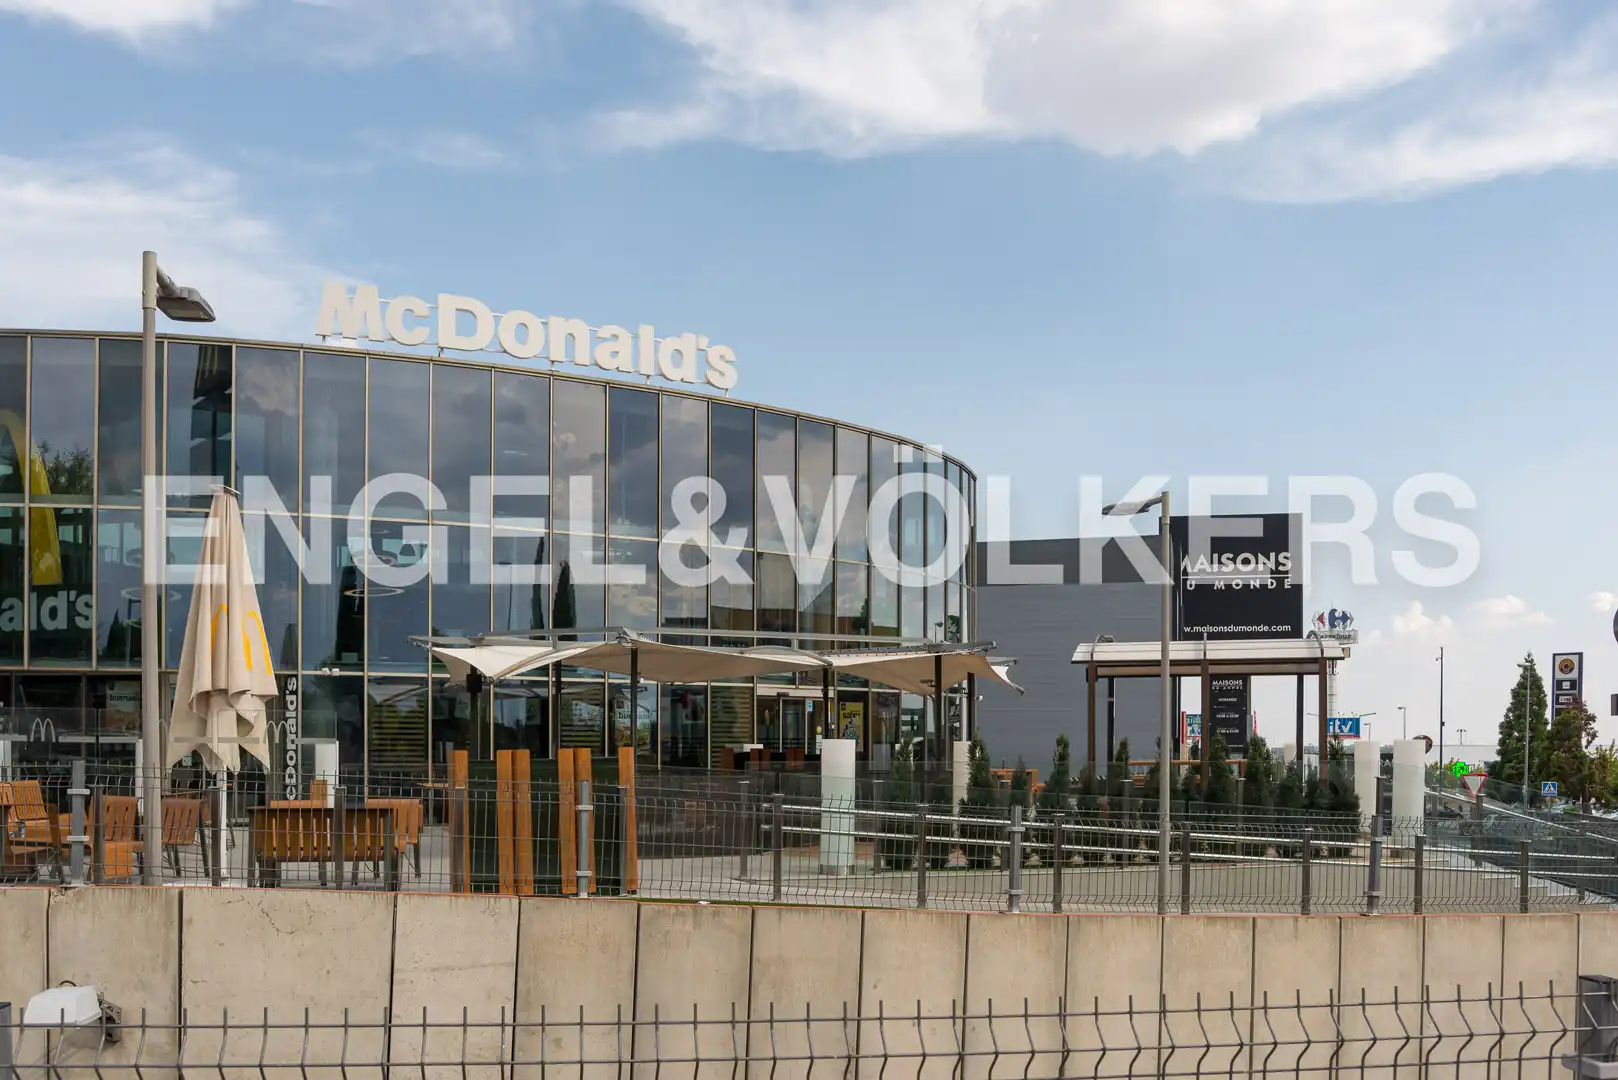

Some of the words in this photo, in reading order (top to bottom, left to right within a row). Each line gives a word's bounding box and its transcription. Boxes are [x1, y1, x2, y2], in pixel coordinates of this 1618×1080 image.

[315, 280, 738, 389] McDonald's
[1187, 580, 1195, 590] U
[1214, 579, 1292, 590] MONDE
[1184, 624, 1291, 633] w.maisonsdumonde.com
[286, 676, 296, 800] cDonald's
